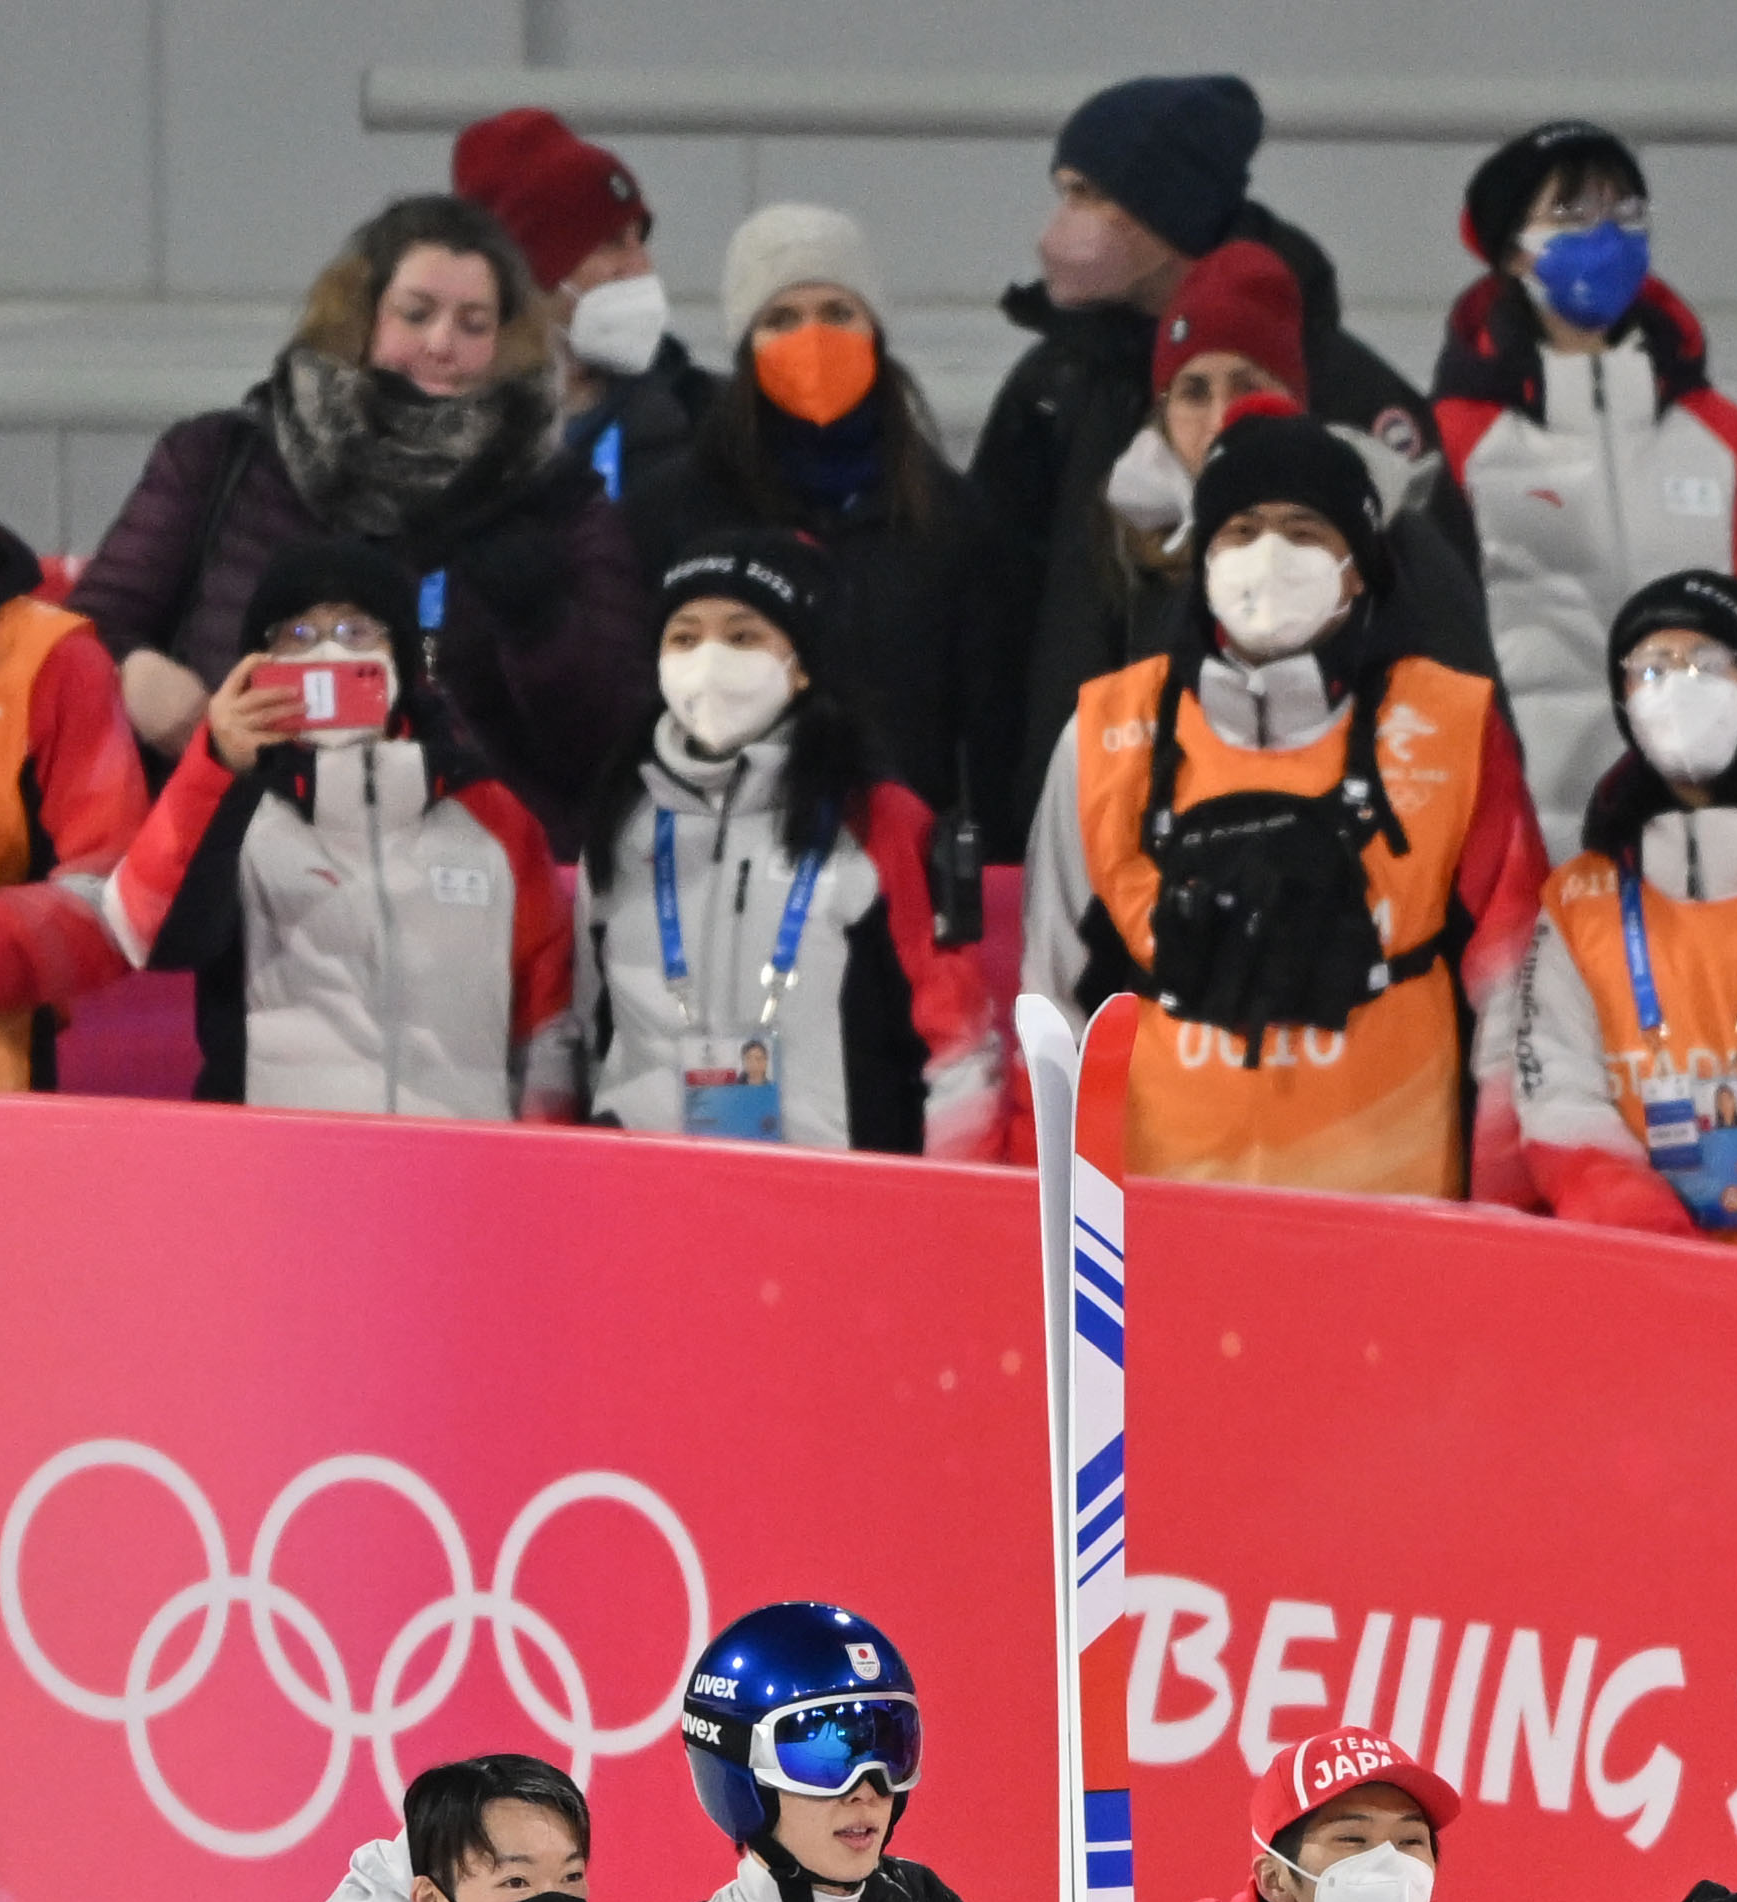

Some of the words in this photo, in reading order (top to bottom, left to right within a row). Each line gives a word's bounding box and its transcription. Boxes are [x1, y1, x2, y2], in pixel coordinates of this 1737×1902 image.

[694, 1673, 739, 1700] uvex
[682, 1711, 722, 1745] uvex
[1124, 1573, 1686, 1851] BEIJING
[1330, 1736, 1391, 1755] TEAM
[1314, 1751, 1403, 1790] JAPA
